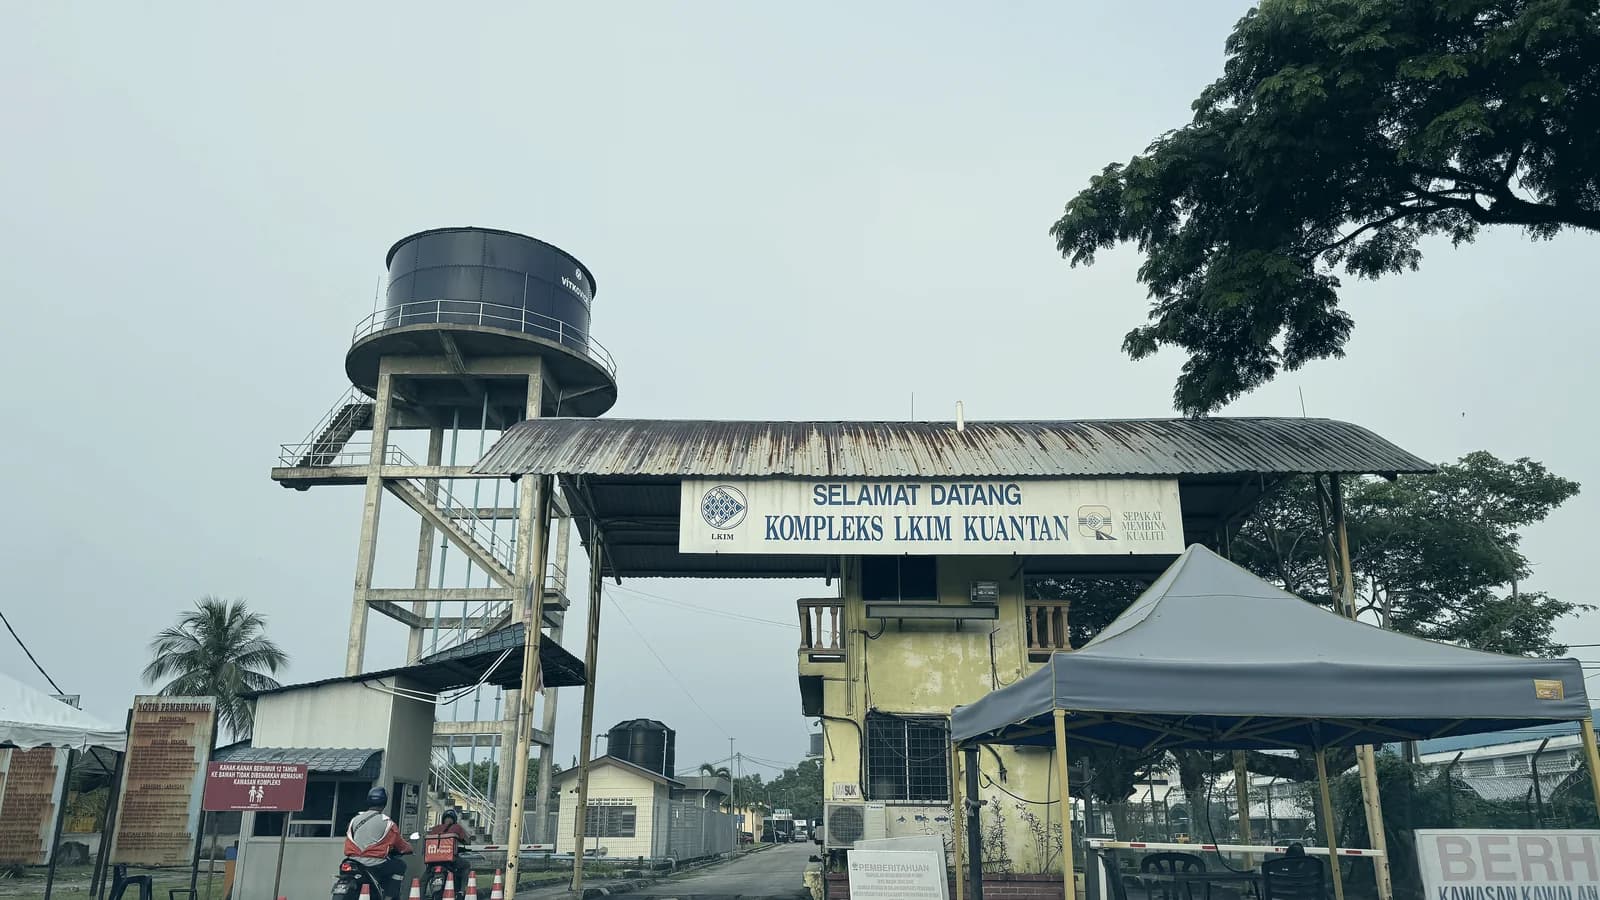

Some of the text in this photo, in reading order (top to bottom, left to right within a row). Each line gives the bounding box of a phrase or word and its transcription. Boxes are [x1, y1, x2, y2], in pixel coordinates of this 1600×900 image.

[813, 484, 1022, 506] SELAMAT DATANG
[1122, 511, 1163, 521] SEPAKAT
[764, 515, 1070, 541] KOMPLEKS LKIM KUANTAN
[1121, 521, 1167, 531] MEMBINA
[711, 533, 734, 541] LKIM
[1126, 531, 1164, 541] KUALITI
[1436, 836, 1600, 881] BERH
[858, 863, 929, 872] PEMBERITAHUAN
